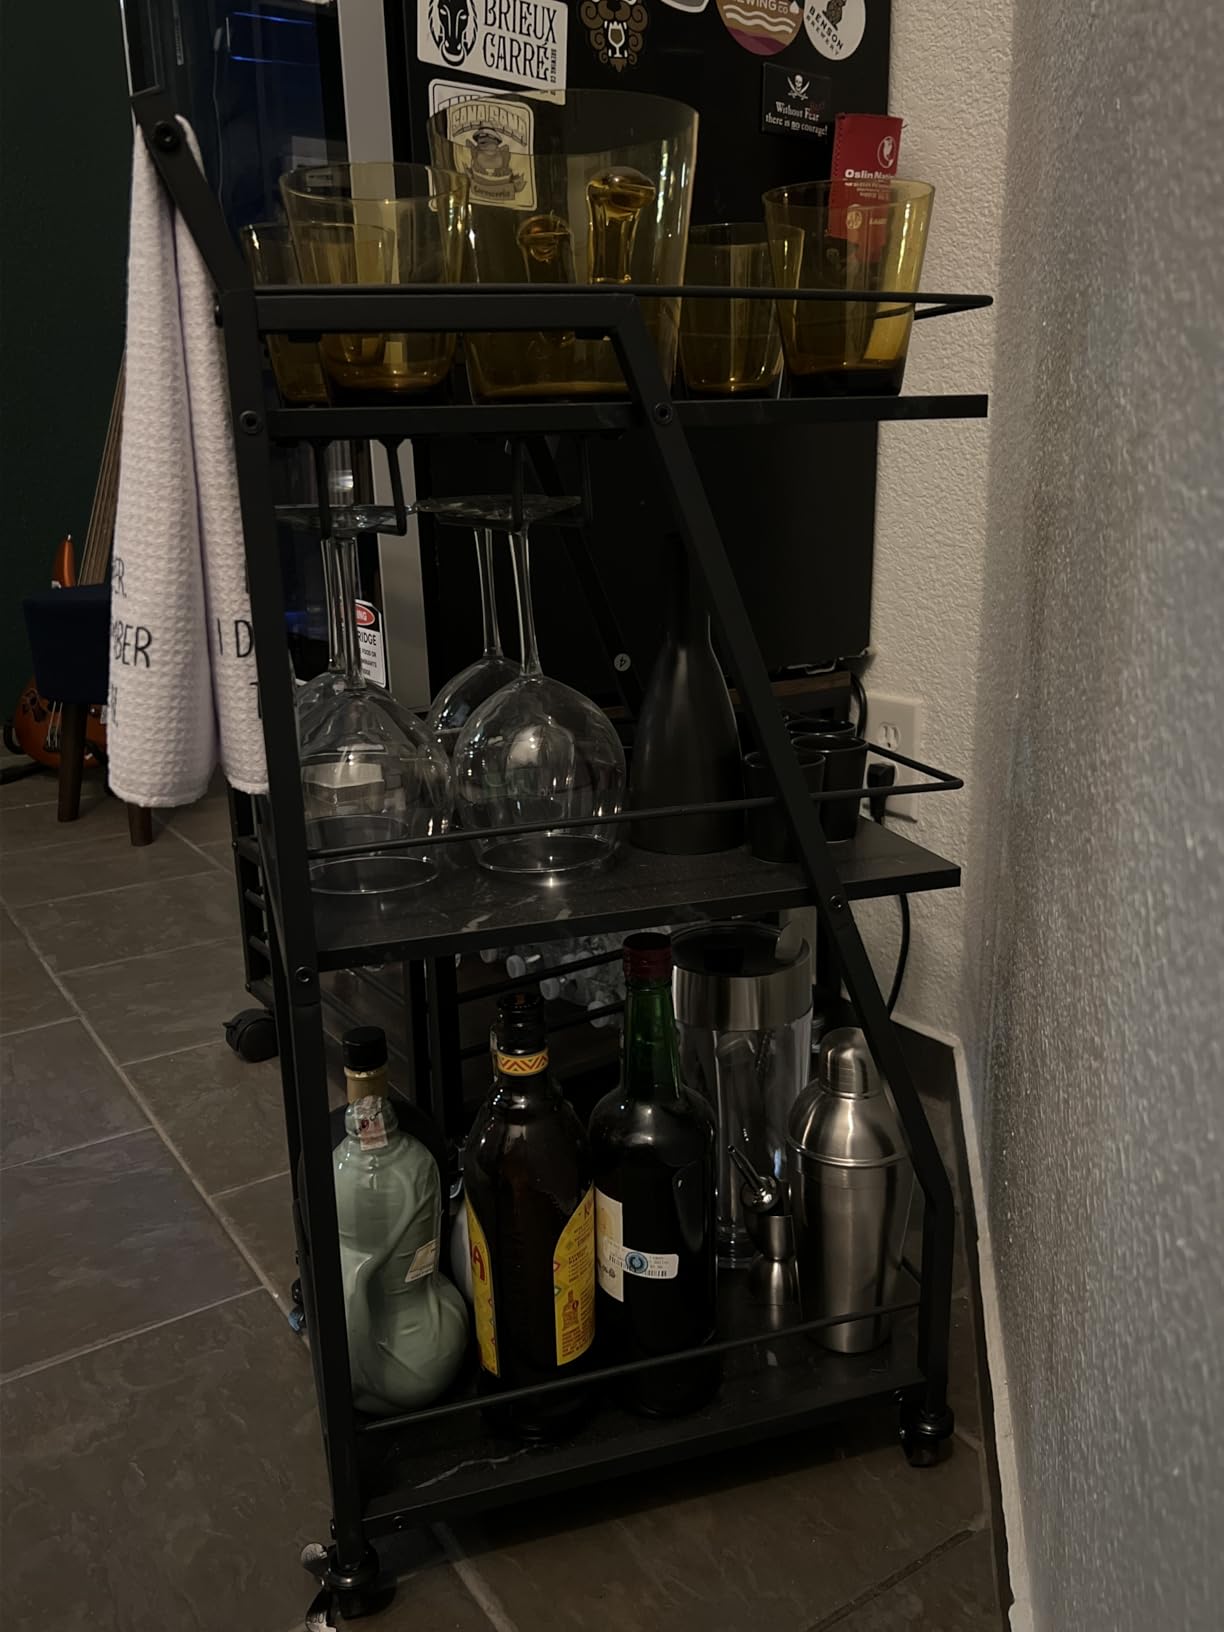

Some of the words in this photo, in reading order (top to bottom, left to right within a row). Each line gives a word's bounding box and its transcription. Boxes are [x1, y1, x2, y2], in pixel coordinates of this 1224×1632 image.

[484, 0, 557, 44] BRIEUX
[809, 6, 844, 50] BENSON
[483, 32, 550, 81] CARRÉ
[765, 112, 783, 126] there
[791, 121, 801, 130] no
[775, 100, 803, 118] Without
[844, 168, 873, 179] Oslin
[112, 621, 152, 668] BER
